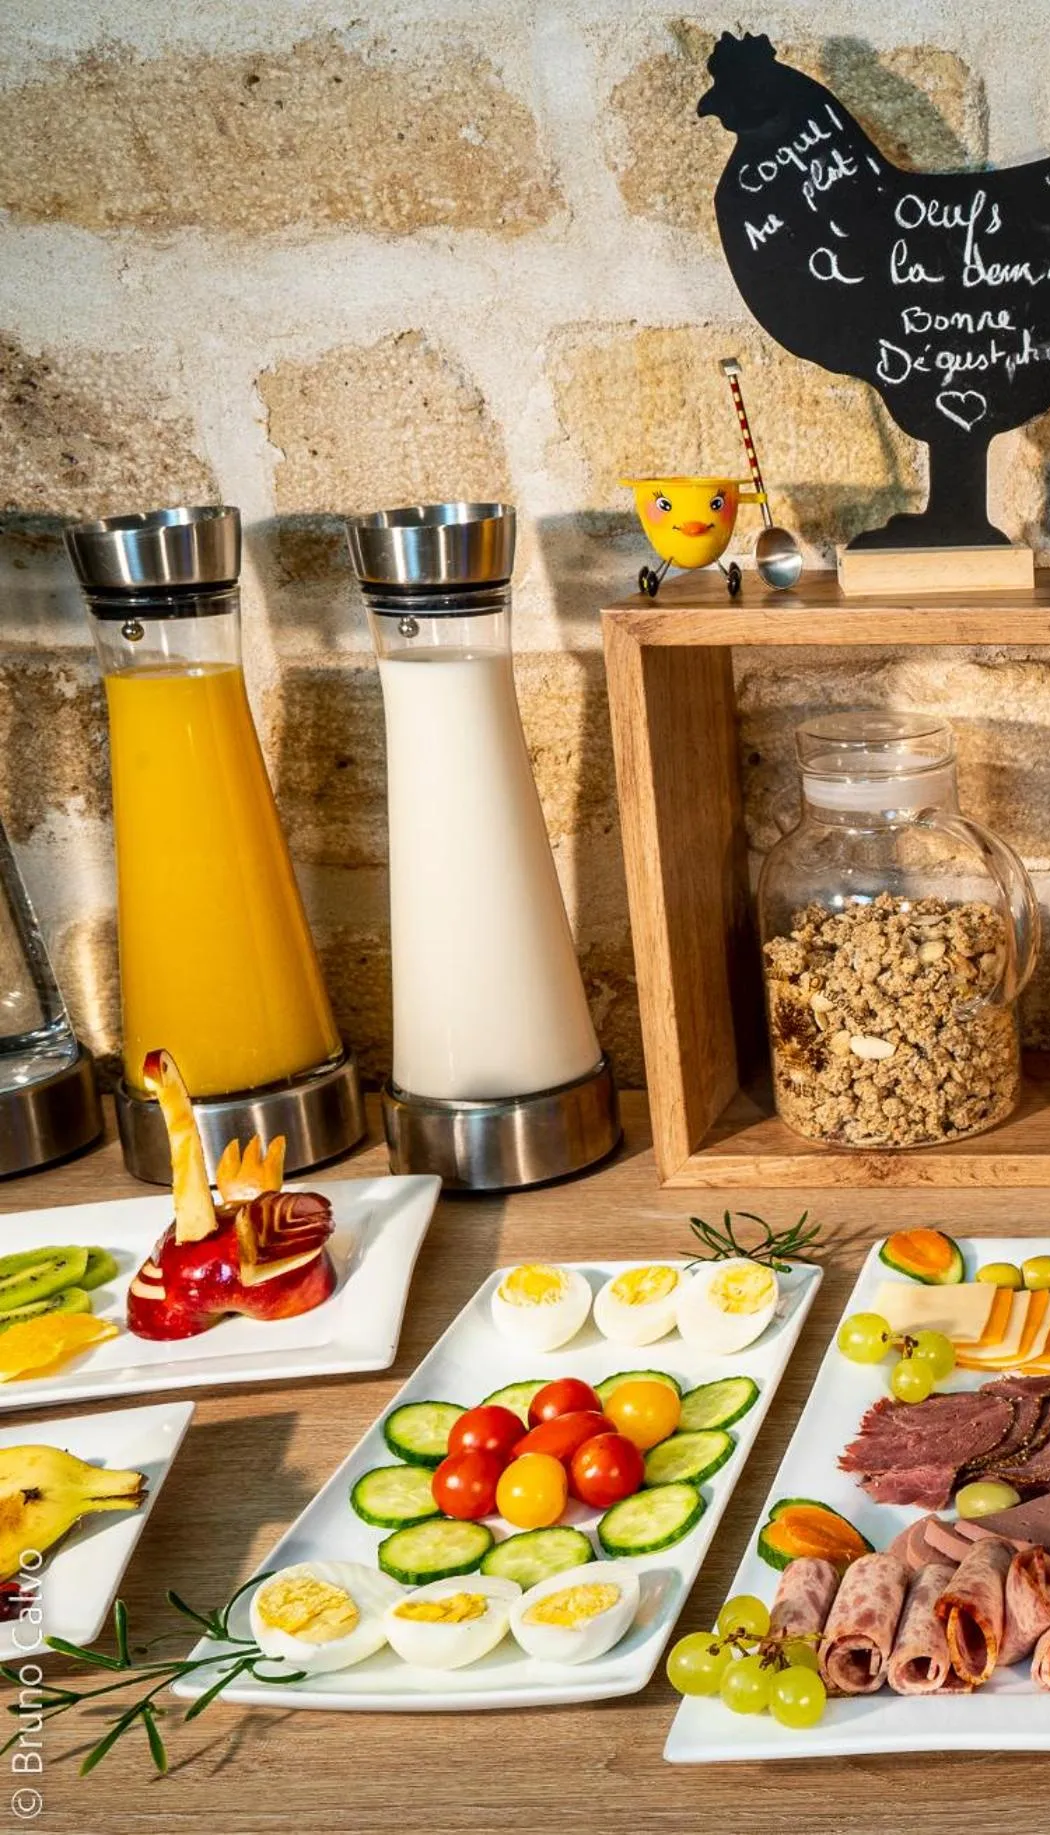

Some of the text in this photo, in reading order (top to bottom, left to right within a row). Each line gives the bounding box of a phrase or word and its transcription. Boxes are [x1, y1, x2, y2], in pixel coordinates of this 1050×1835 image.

[809, 220, 864, 284] à
[891, 239, 945, 284] la
[900, 306, 1016, 335] Bonne
